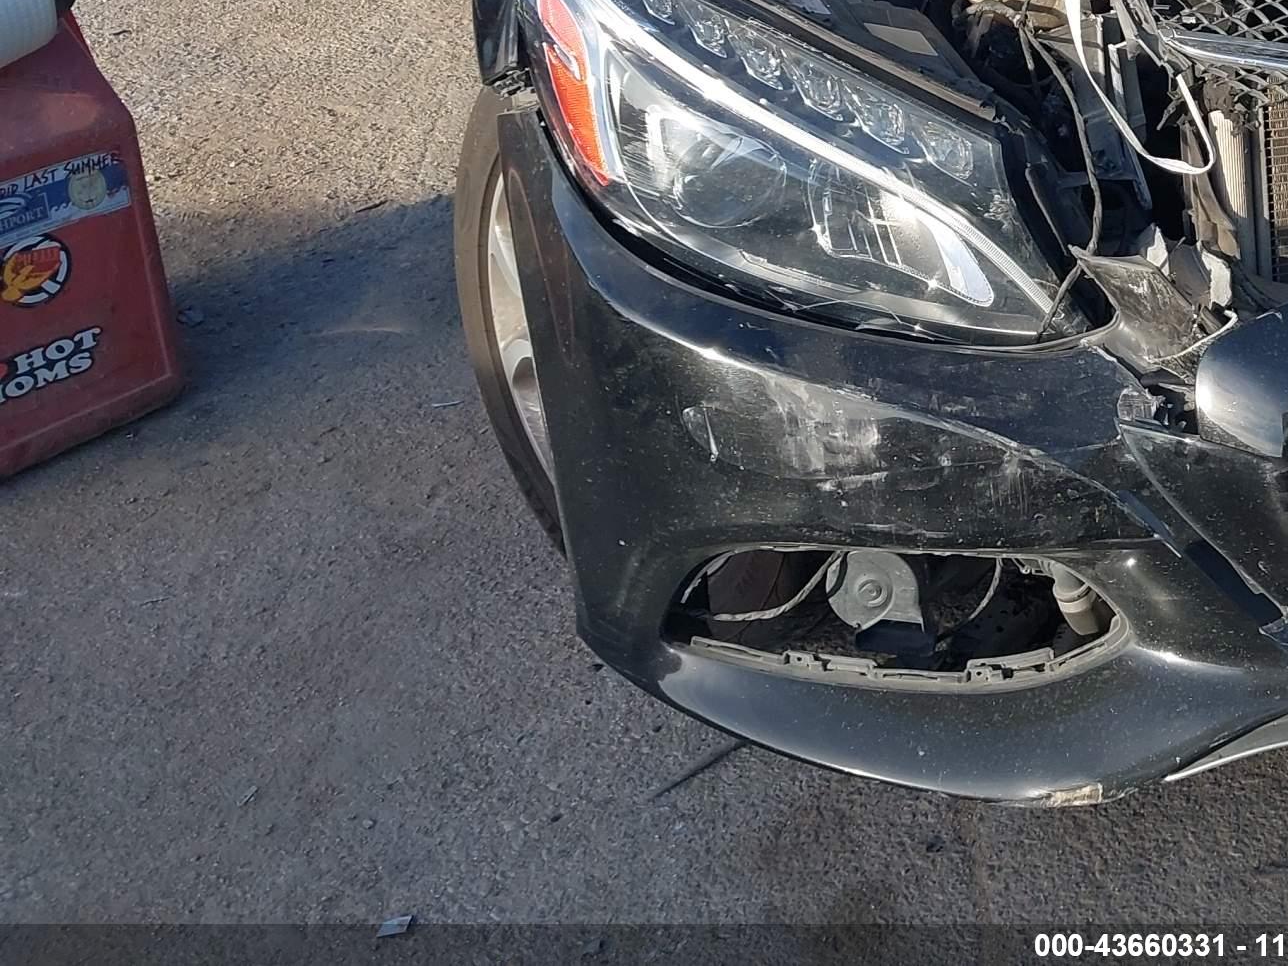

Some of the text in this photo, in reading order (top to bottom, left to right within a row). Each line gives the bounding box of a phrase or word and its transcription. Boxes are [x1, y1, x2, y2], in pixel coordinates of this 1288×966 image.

[24, 168, 58, 191] LAST
[63, 152, 123, 178] SUMMER
[14, 327, 101, 375] HOT
[0, 352, 92, 404] OMS
